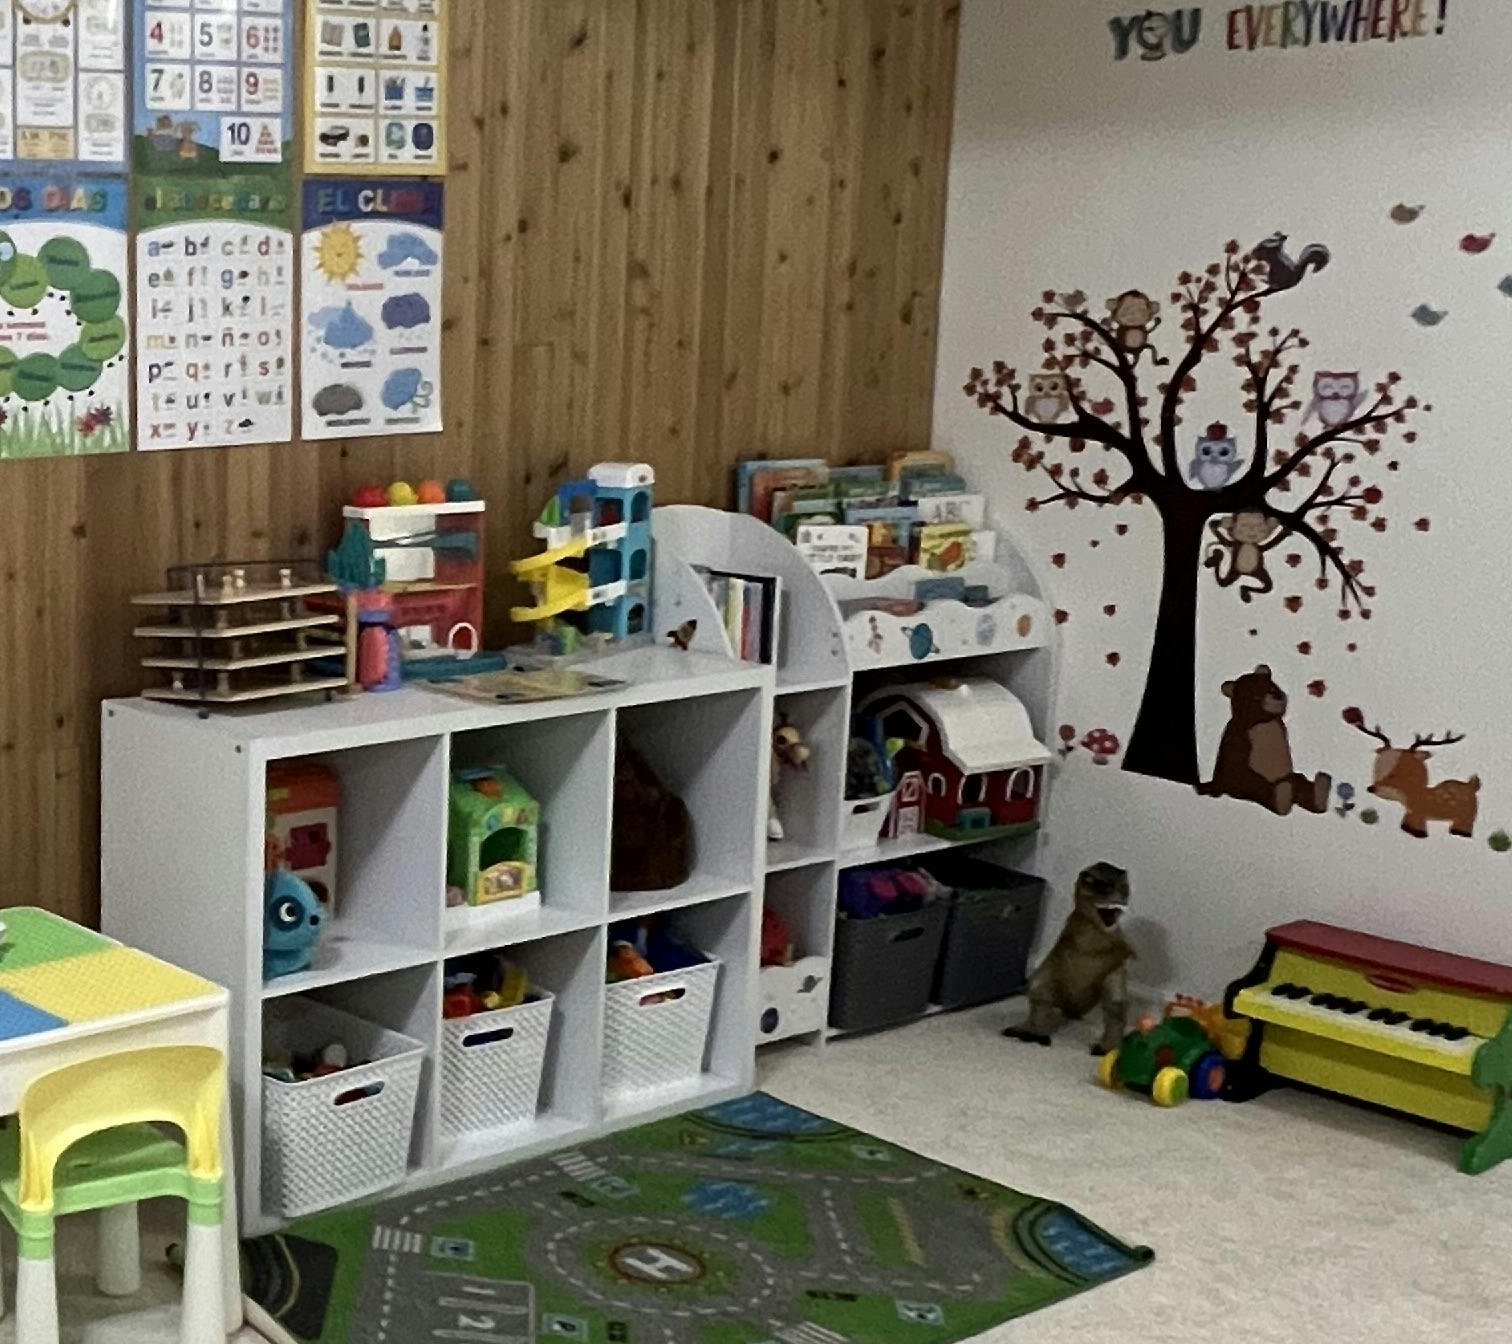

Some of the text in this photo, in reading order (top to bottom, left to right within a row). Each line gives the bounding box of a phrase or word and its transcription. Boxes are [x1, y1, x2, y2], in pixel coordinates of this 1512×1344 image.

[149, 20, 260, 50] 4 5 6
[1108, 8, 1202, 61] YOU
[150, 68, 259, 96] 7 8 9
[226, 121, 251, 146] 10
[317, 188, 351, 213] EL
[148, 235, 270, 257] a b c d
[148, 272, 160, 288] e
[220, 268, 234, 290] g
[221, 296, 234, 317] k
[146, 326, 270, 350] m n ñ o
[149, 360, 270, 383] p q r s
[186, 393, 198, 409] u
[223, 392, 235, 407] v
[150, 423, 162, 439] x
[187, 421, 199, 442] y
[624, 1246, 695, 1280] H
[457, 1312, 497, 1330] 2
